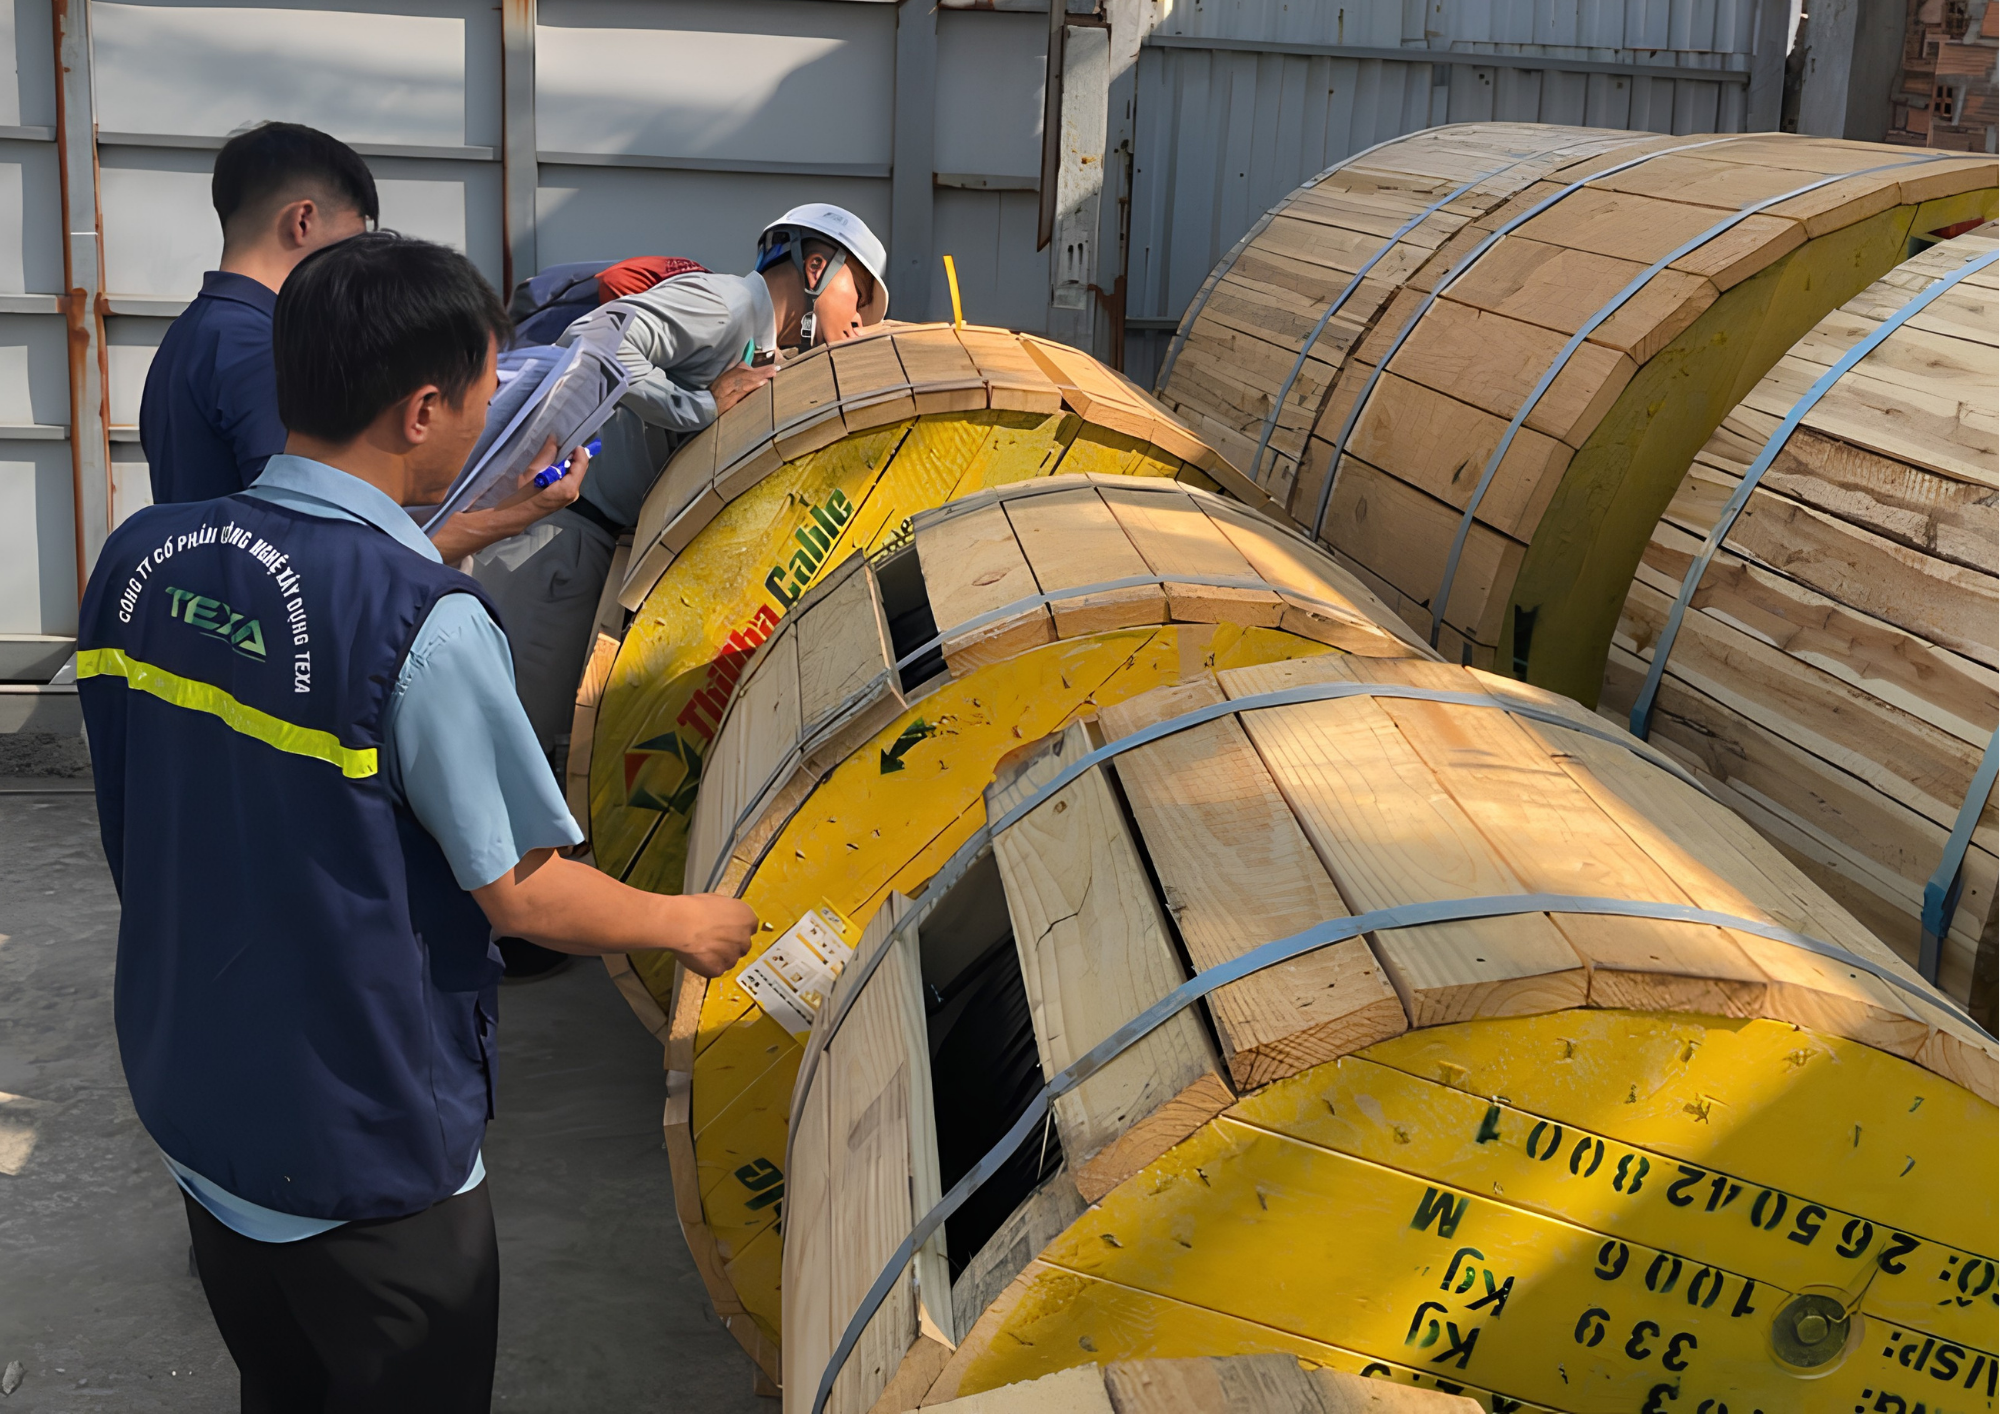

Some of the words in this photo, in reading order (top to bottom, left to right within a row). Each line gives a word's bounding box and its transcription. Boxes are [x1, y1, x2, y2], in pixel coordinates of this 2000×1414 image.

[165, 586, 267, 657] TEXA
[294, 650, 311, 693] TEXA
[1409, 1187, 1470, 1240] M
[1440, 1247, 1516, 1317] Kg
[1404, 1301, 1480, 1370] Kg
[1574, 1308, 1698, 1372] 339
